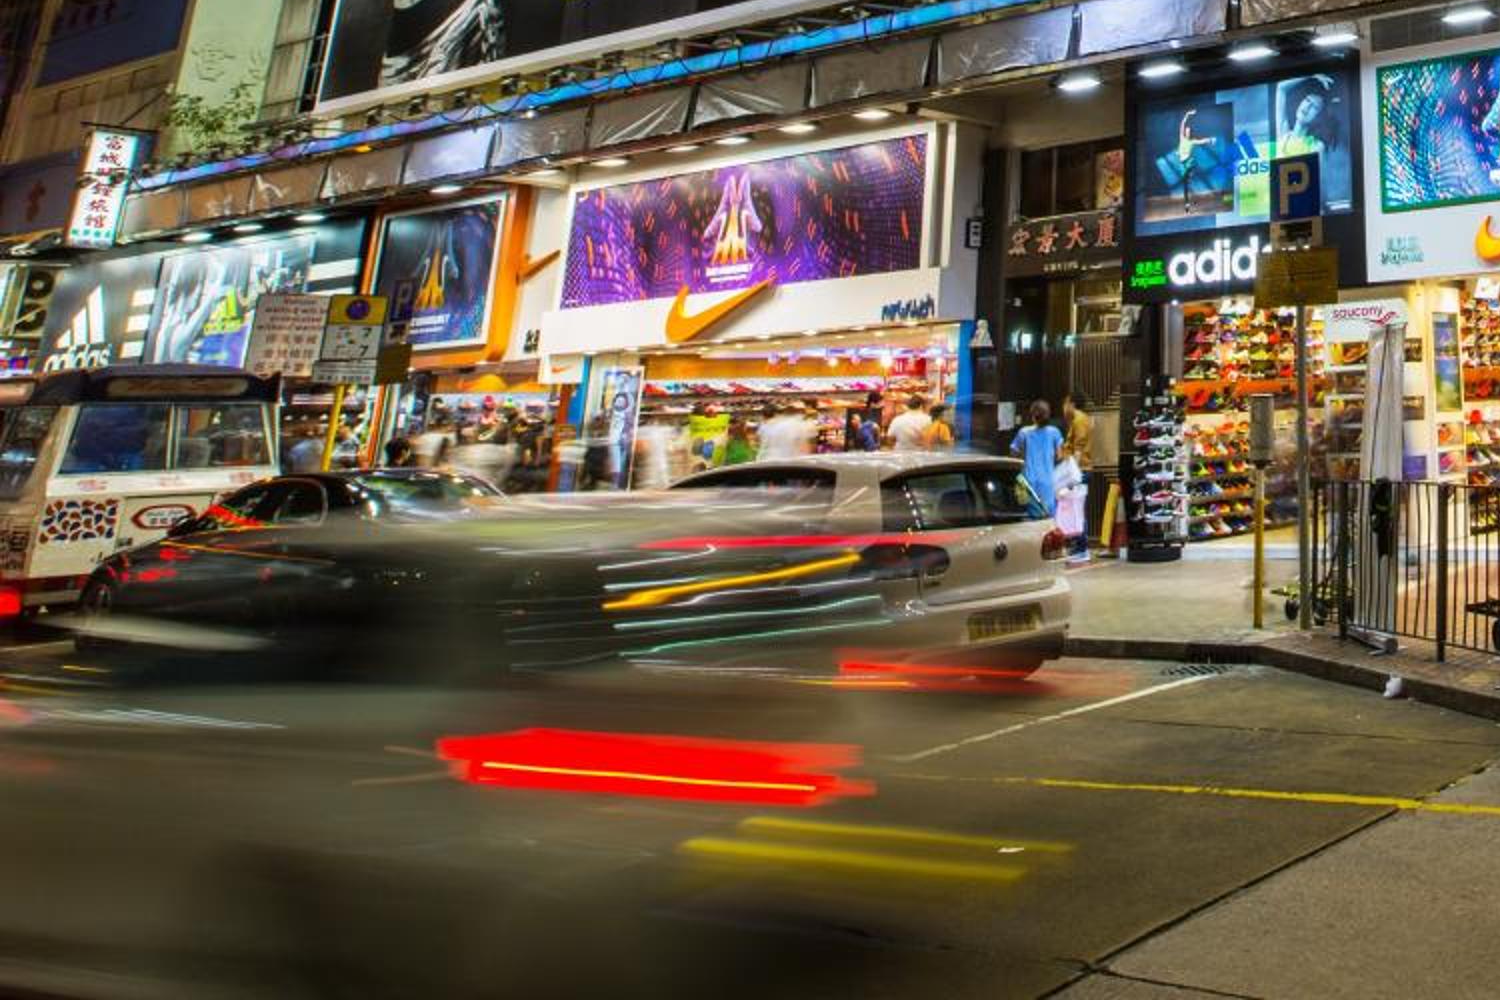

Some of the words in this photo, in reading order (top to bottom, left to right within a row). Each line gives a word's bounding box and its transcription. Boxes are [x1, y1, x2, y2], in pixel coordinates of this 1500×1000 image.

[1279, 161, 1310, 216] P
[1168, 234, 1310, 285] adid
[1332, 305, 1384, 324] saucony
